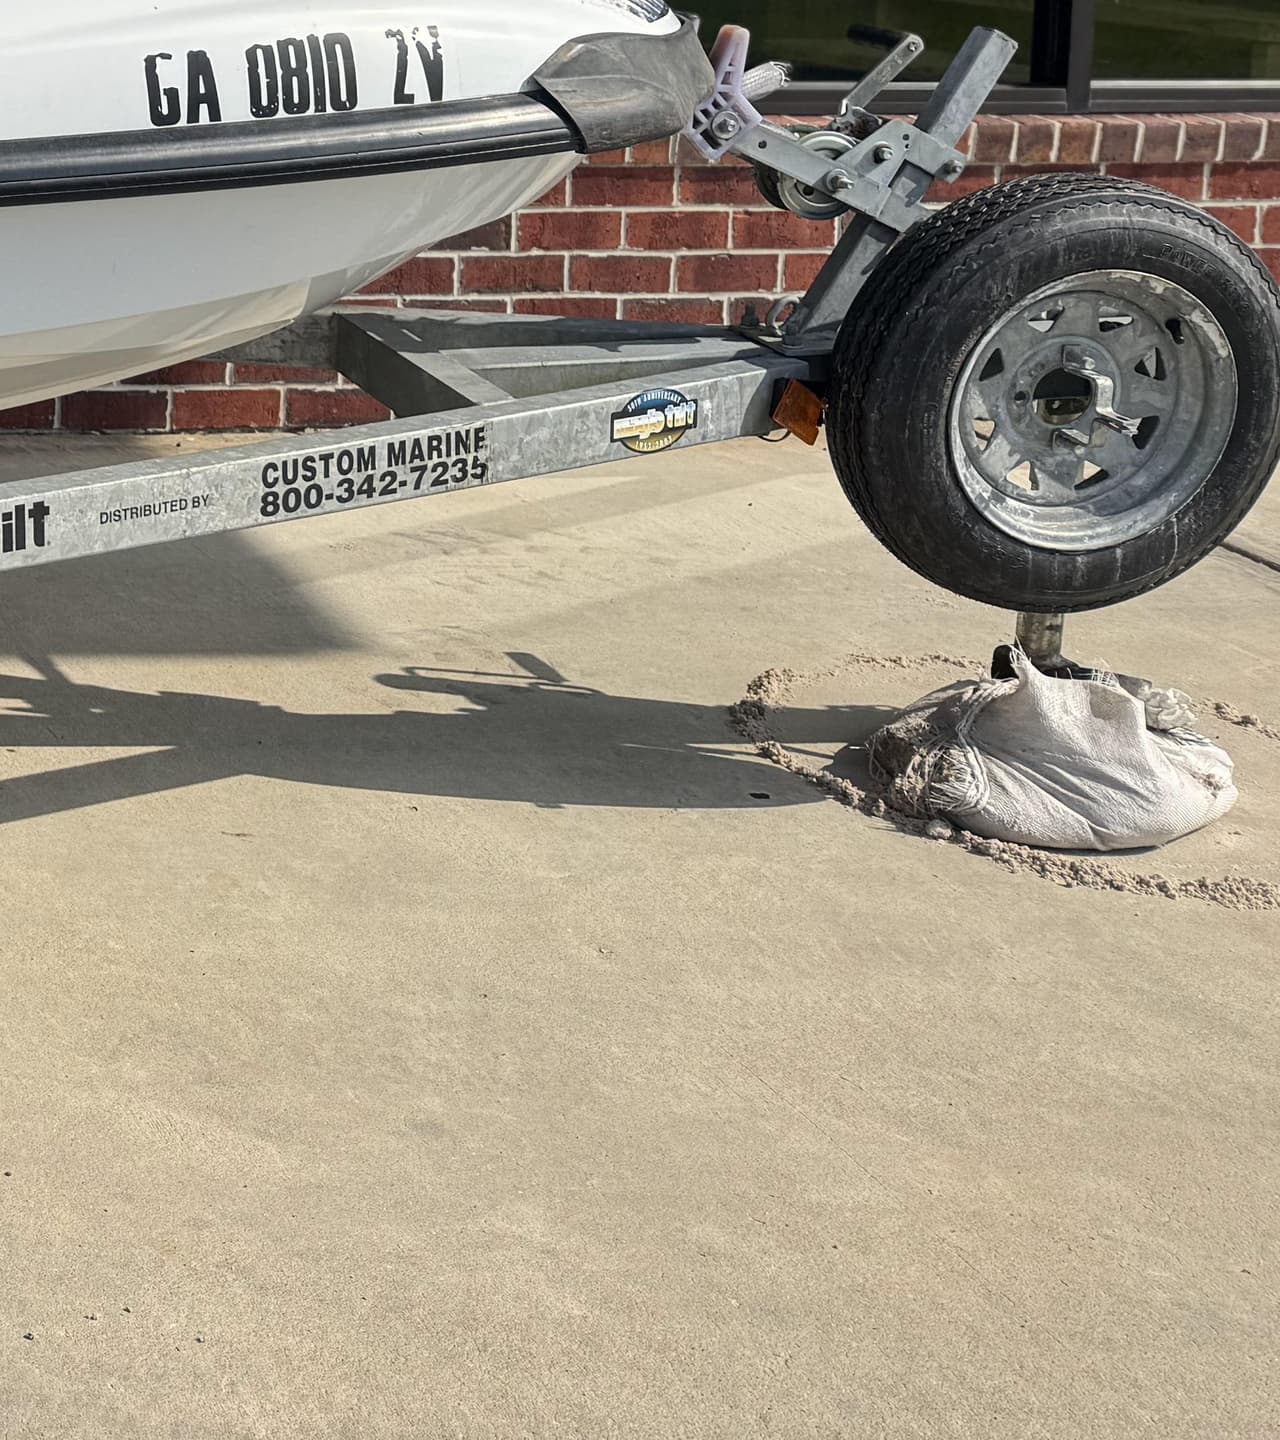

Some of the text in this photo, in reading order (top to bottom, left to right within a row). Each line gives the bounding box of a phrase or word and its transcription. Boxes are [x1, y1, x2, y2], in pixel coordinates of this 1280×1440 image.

[143, 49, 223, 127] GA
[245, 31, 359, 118] 0810
[259, 455, 488, 517] 800-342-7235
[261, 426, 487, 489] CUSTOM MARINE
[99, 494, 210, 525] DISTRIBUTED BY
